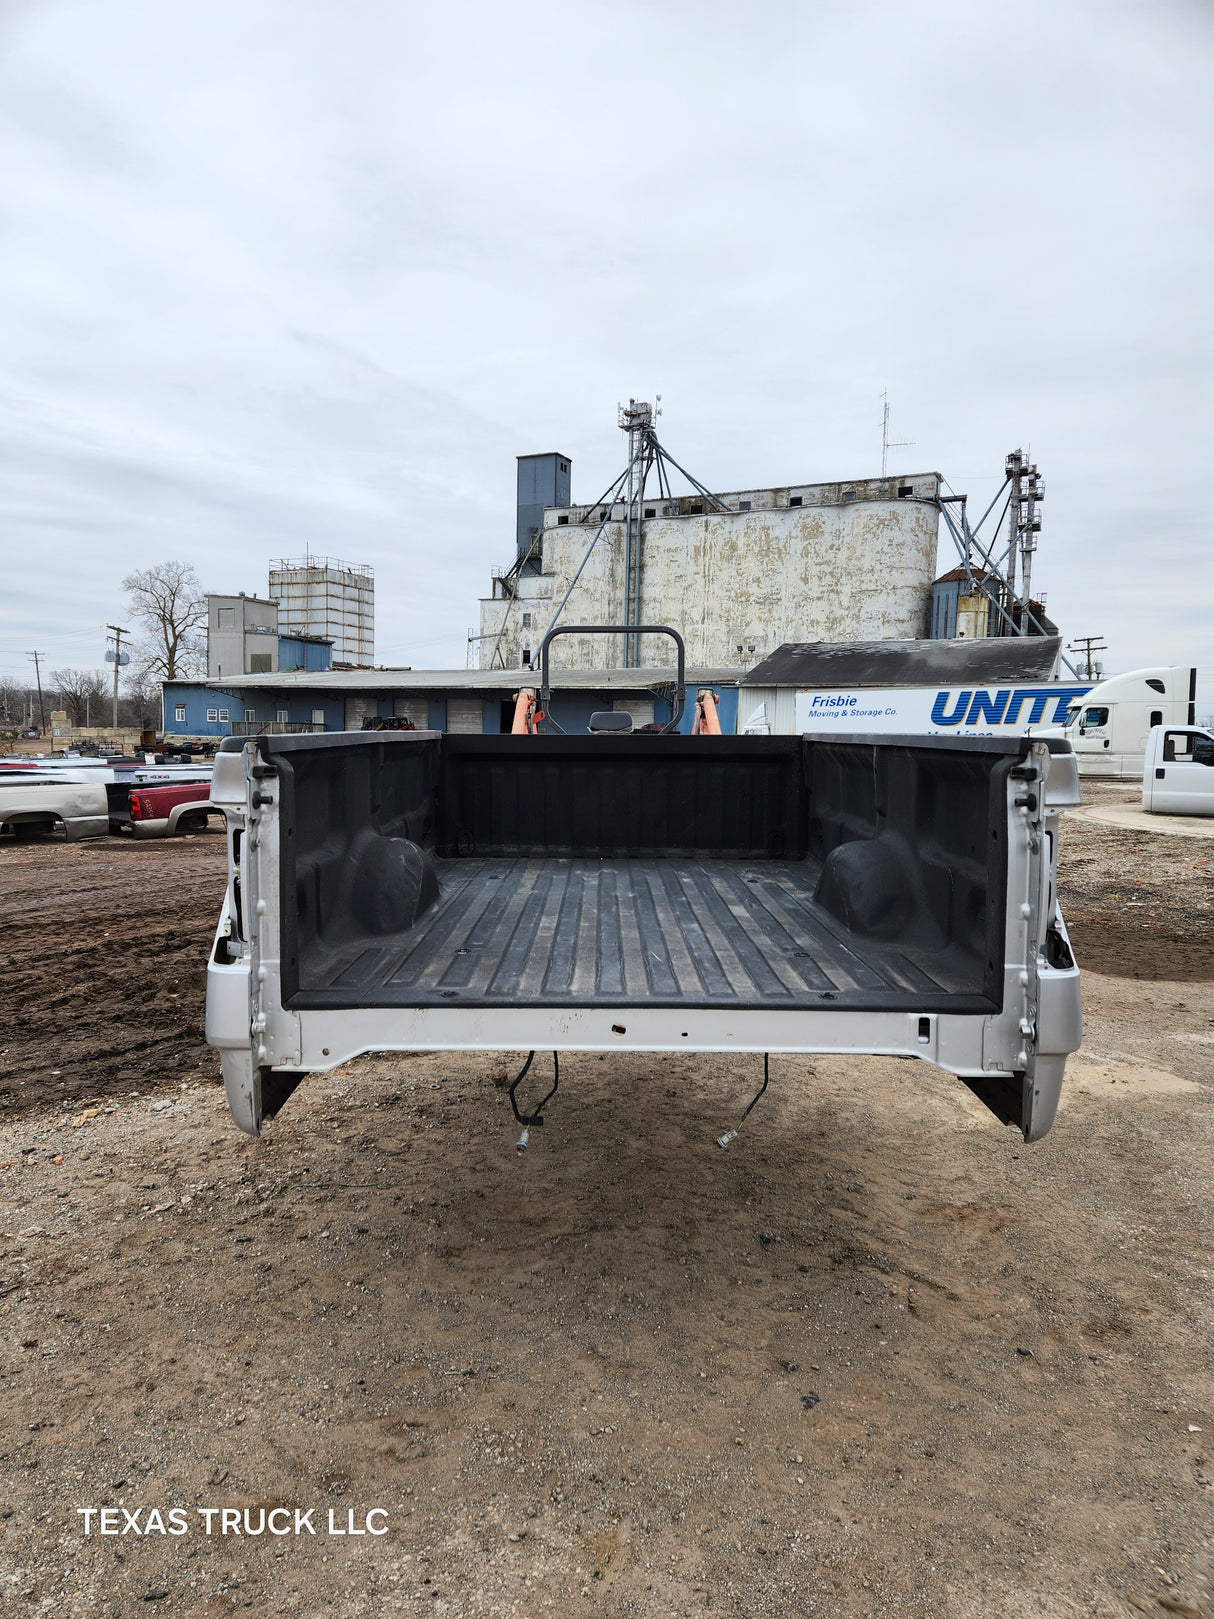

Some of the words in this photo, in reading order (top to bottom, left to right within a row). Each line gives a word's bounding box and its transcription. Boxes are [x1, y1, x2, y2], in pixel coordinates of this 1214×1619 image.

[811, 695, 857, 707] Frisbie
[931, 687, 1094, 727] UNITE
[808, 709, 839, 718] Moving
[840, 709, 848, 717] &
[850, 708, 883, 717] Storage
[884, 707, 898, 716] Co.
